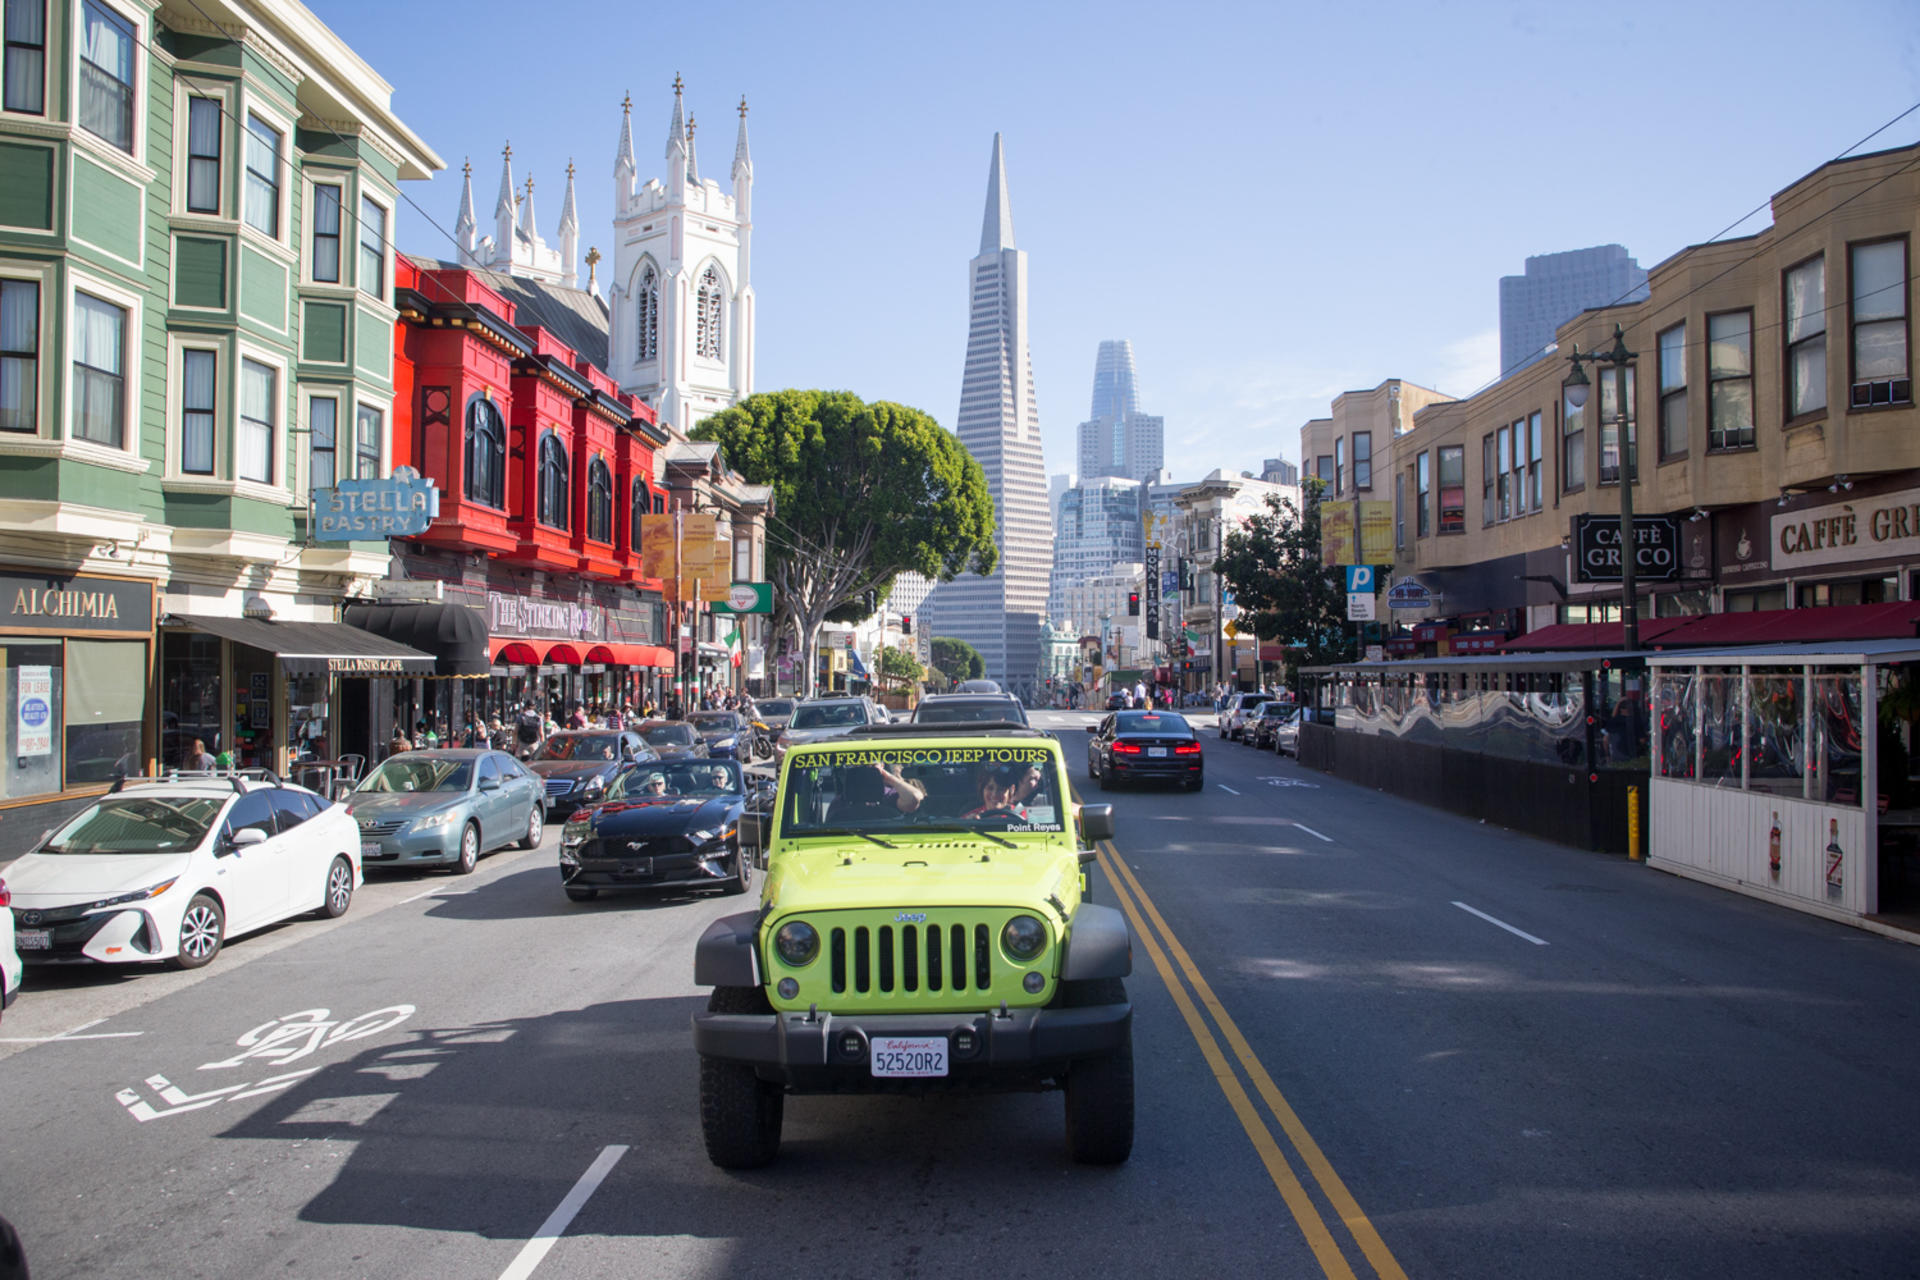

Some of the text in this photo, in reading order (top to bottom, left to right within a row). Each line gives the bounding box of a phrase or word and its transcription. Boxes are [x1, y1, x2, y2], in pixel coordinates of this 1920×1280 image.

[330, 491, 426, 512] STELLA
[322, 516, 411, 532] PASTRY
[1780, 505, 1857, 554] CAFFÈ
[1596, 524, 1662, 544] CAFÈ
[1147, 549, 1158, 579] MONA
[1587, 548, 1671, 566] GRCO
[1351, 567, 1371, 590] P
[11, 588, 119, 618] ALCHIMIA
[489, 591, 517, 631] THE
[519, 596, 568, 632] STINKING
[328, 658, 355, 671] STELLA
[21, 680, 50, 694] FOR LEASE
[795, 749, 1048, 768] SAN FRANCISCO JEEP TOURS
[1007, 823, 1061, 833] Point Reyes
[894, 911, 927, 923] Jeep
[886, 1039, 930, 1052] California
[876, 1053, 943, 1071] 52520R2
